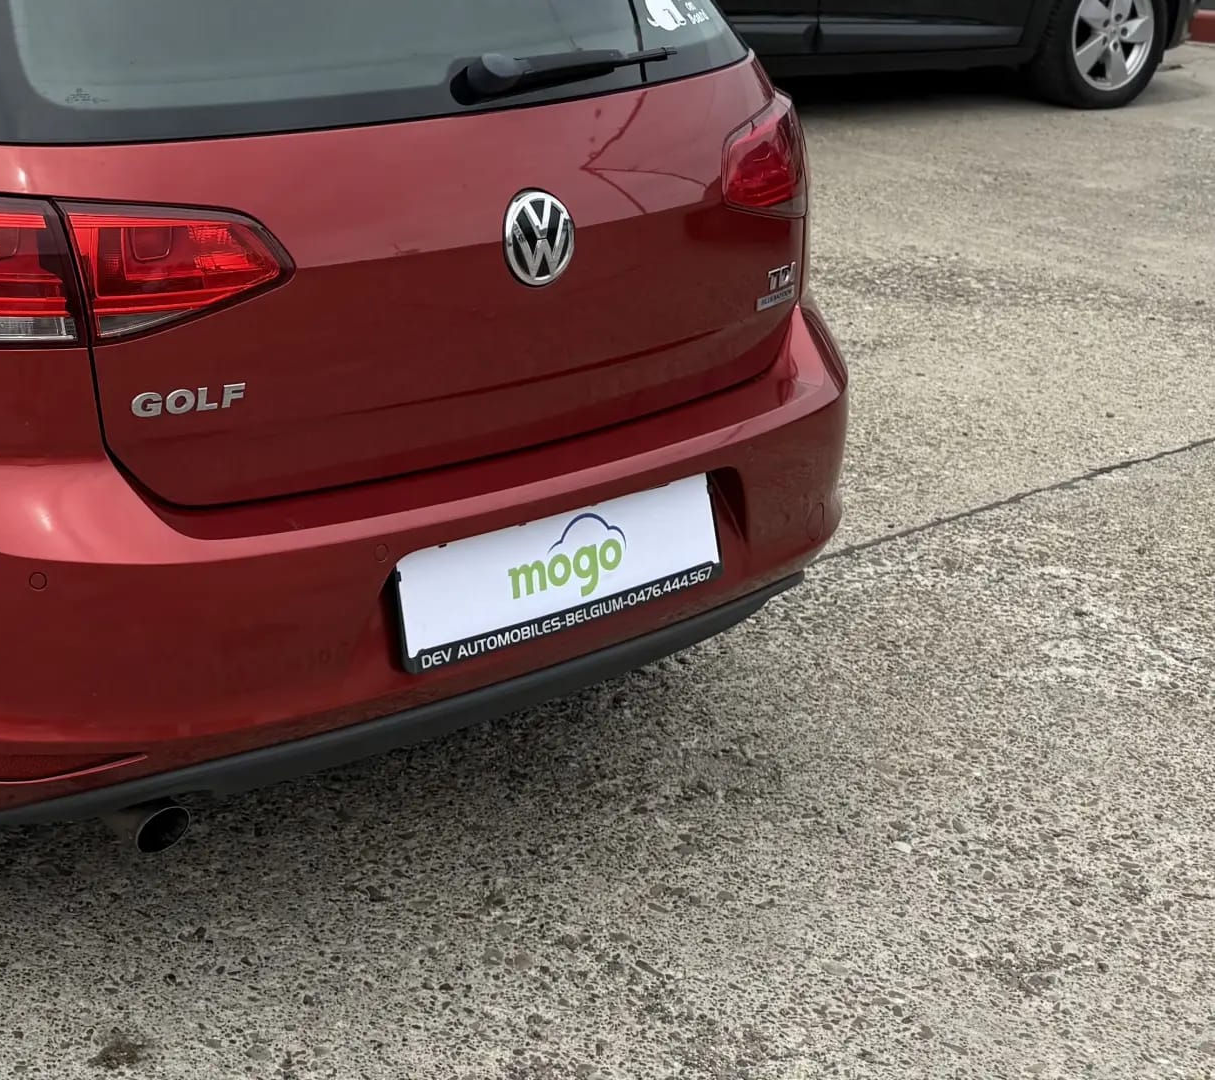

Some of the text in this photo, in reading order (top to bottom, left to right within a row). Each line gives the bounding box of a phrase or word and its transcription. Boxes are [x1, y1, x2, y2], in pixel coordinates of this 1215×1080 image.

[768, 262, 796, 290] TDI
[131, 382, 246, 417] GOLF
[508, 538, 623, 598] mogo
[421, 650, 452, 669] DEV
